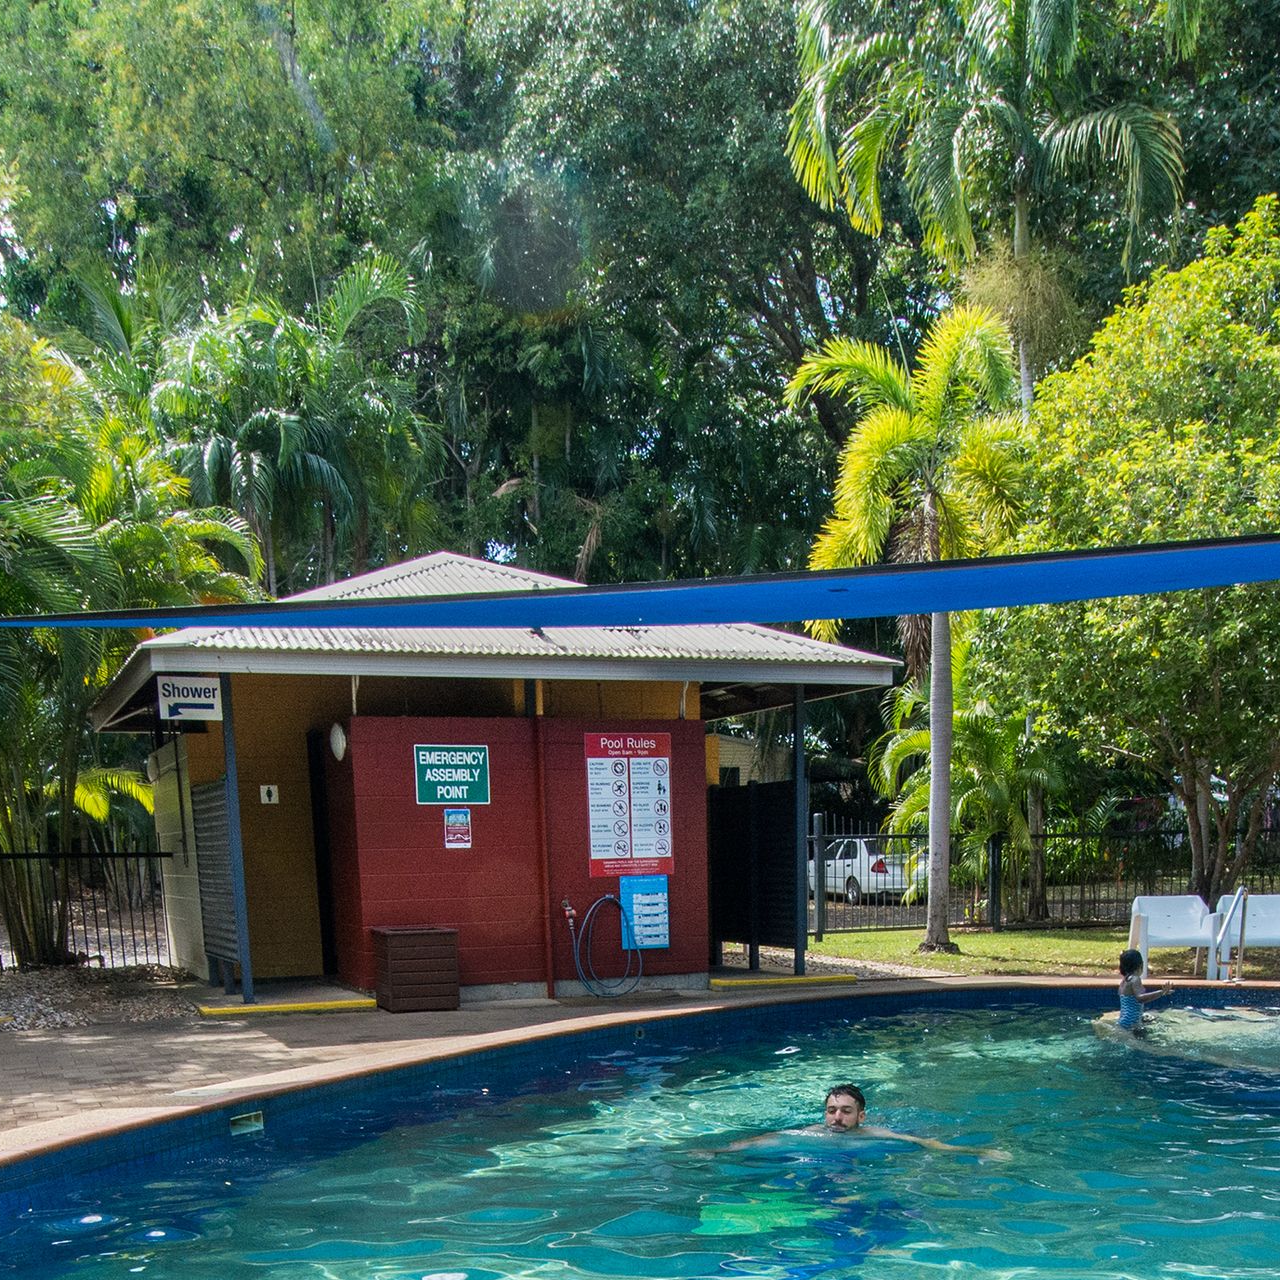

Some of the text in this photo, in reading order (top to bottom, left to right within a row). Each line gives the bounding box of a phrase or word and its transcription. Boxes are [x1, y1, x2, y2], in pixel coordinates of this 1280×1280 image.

[162, 683, 218, 699] Shower
[600, 737, 656, 748] Pool Rules
[419, 751, 484, 765] EMERGENCY
[425, 768, 480, 782] ASSEMBLY
[437, 785, 469, 799] POINT
